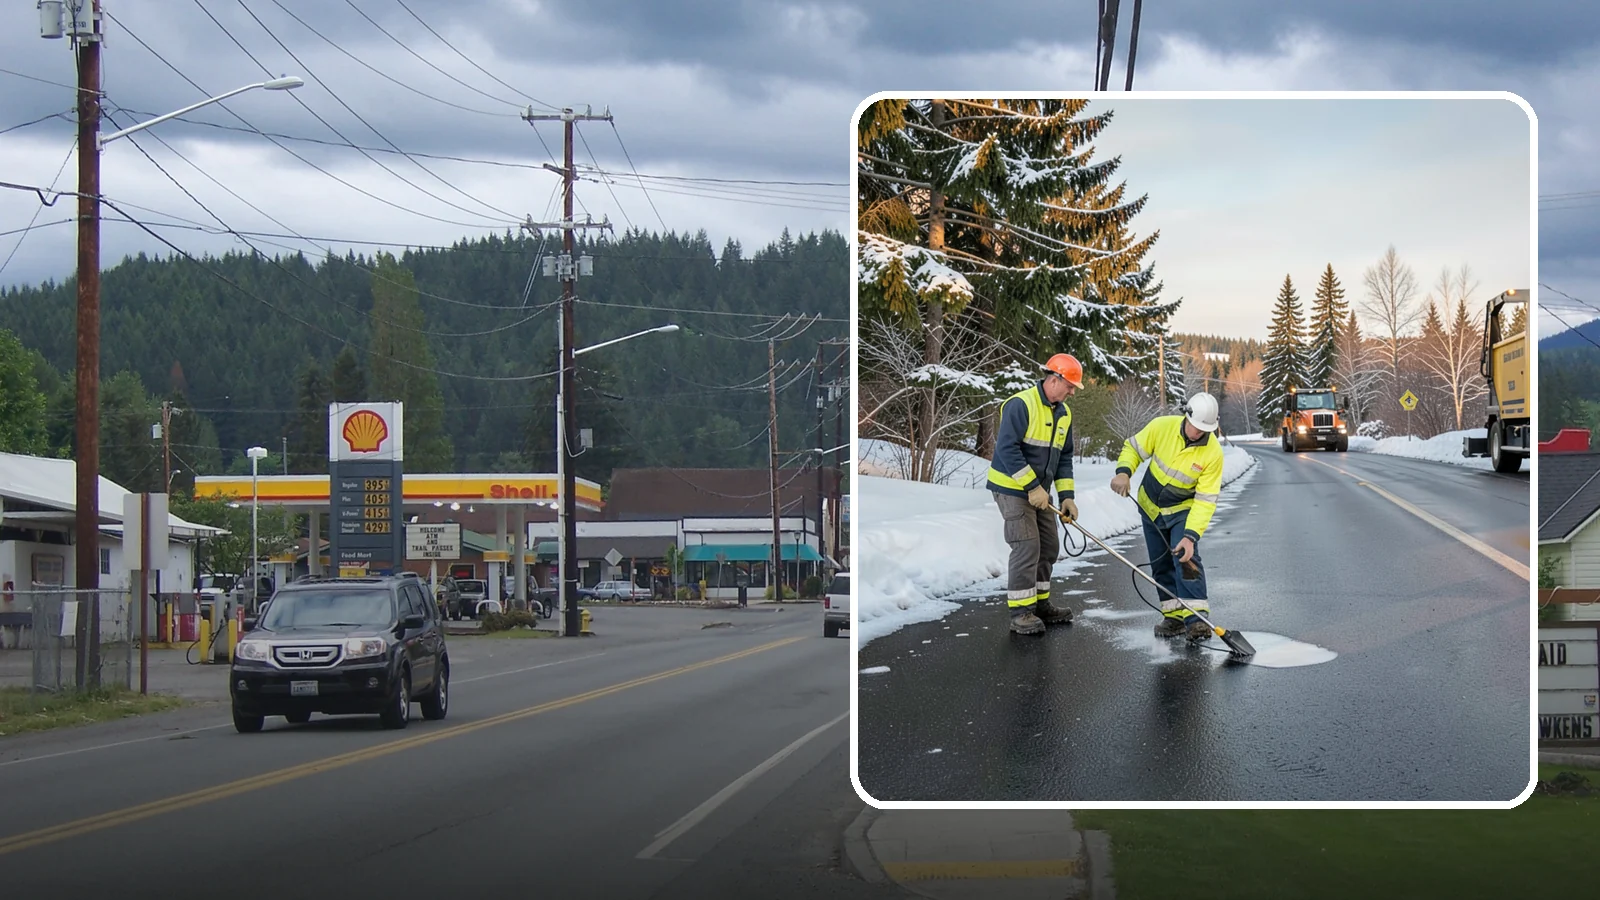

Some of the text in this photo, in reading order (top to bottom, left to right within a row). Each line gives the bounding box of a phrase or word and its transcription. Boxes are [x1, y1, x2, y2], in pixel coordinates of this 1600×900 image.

[366, 480, 384, 490] 395
[490, 484, 547, 499] Shell
[366, 494, 384, 504] 405
[366, 508, 384, 518] 415
[366, 522, 384, 532] 429
[1538, 642, 1567, 665] AID
[1538, 716, 1592, 738] WKENS
